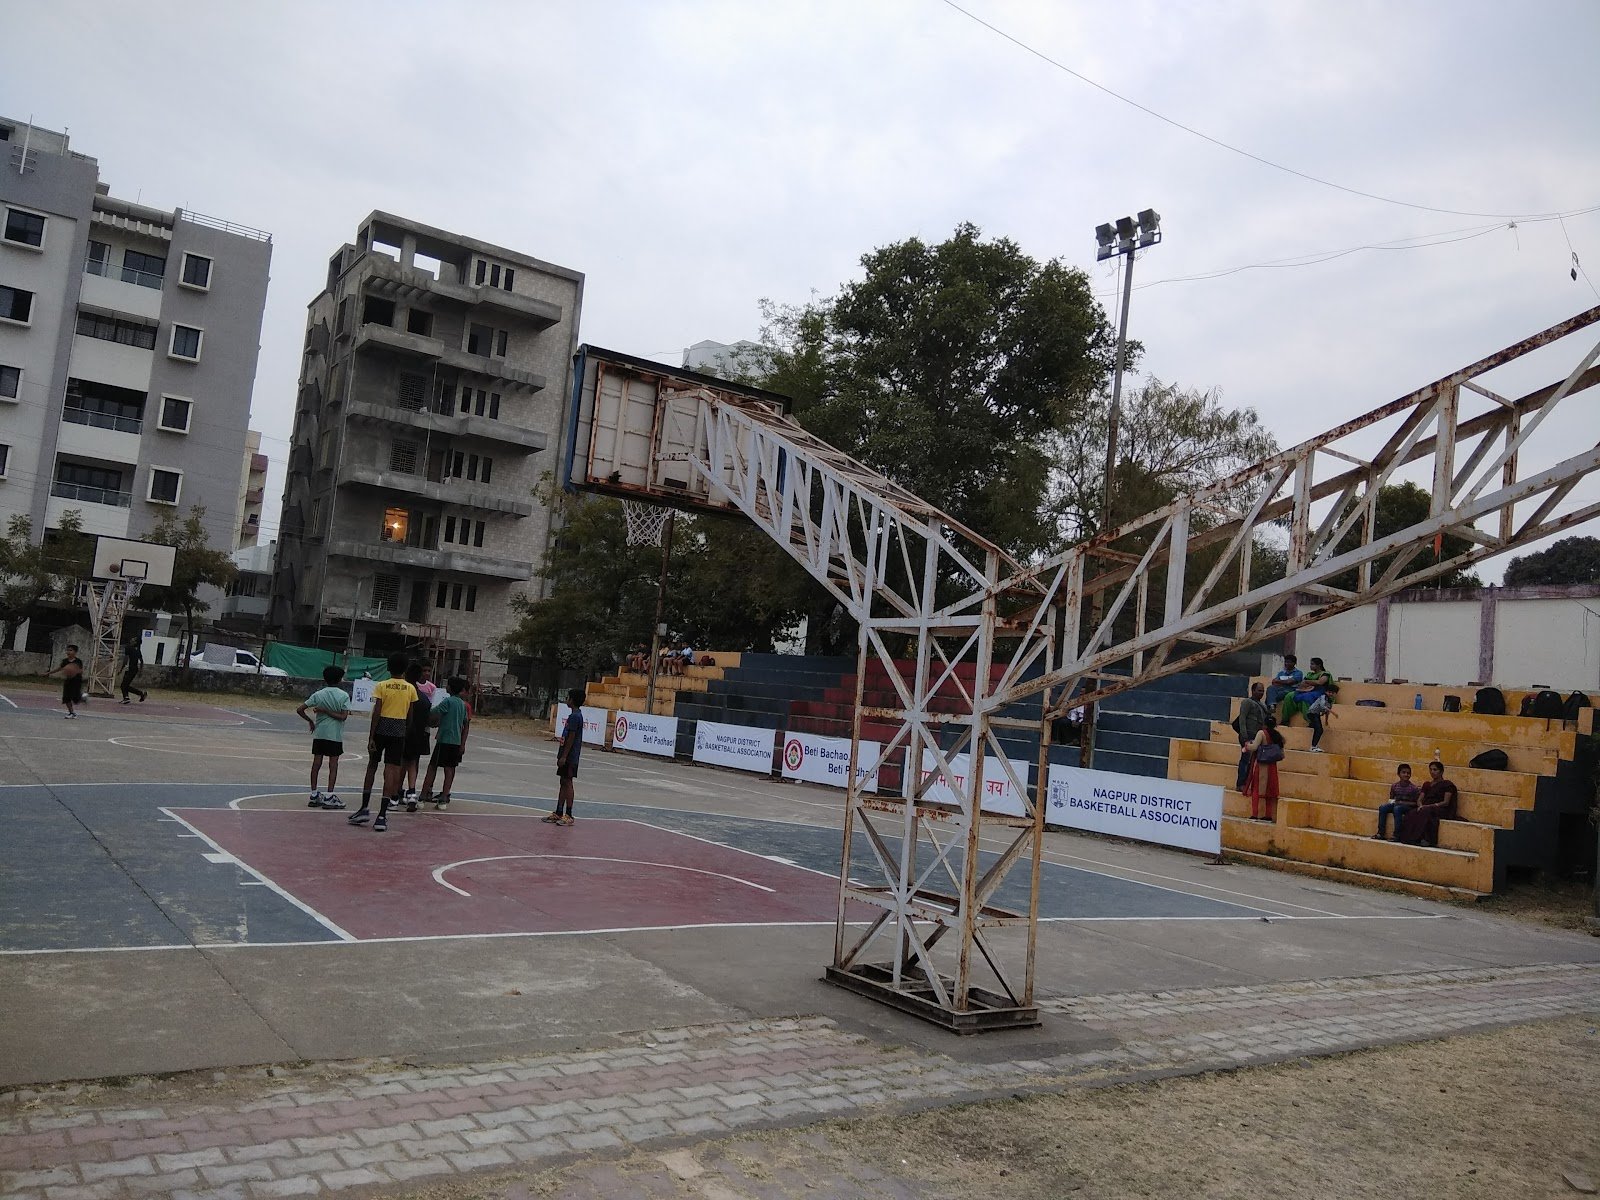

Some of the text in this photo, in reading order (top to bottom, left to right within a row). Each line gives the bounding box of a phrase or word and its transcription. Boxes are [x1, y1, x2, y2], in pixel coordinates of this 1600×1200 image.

[629, 721, 638, 731] Beti
[643, 735, 674, 748] Beti Padhao!
[716, 734, 760, 747] NAGPUR DISTRICT
[705, 743, 771, 758] BASKETBALL ASSOCIATION
[804, 745, 819, 756] Beti
[828, 763, 843, 775] Beti
[1093, 788, 1192, 812] NAGPUR DISTRICT
[1070, 797, 1218, 831] BASKETBALL ASSOCIATION
